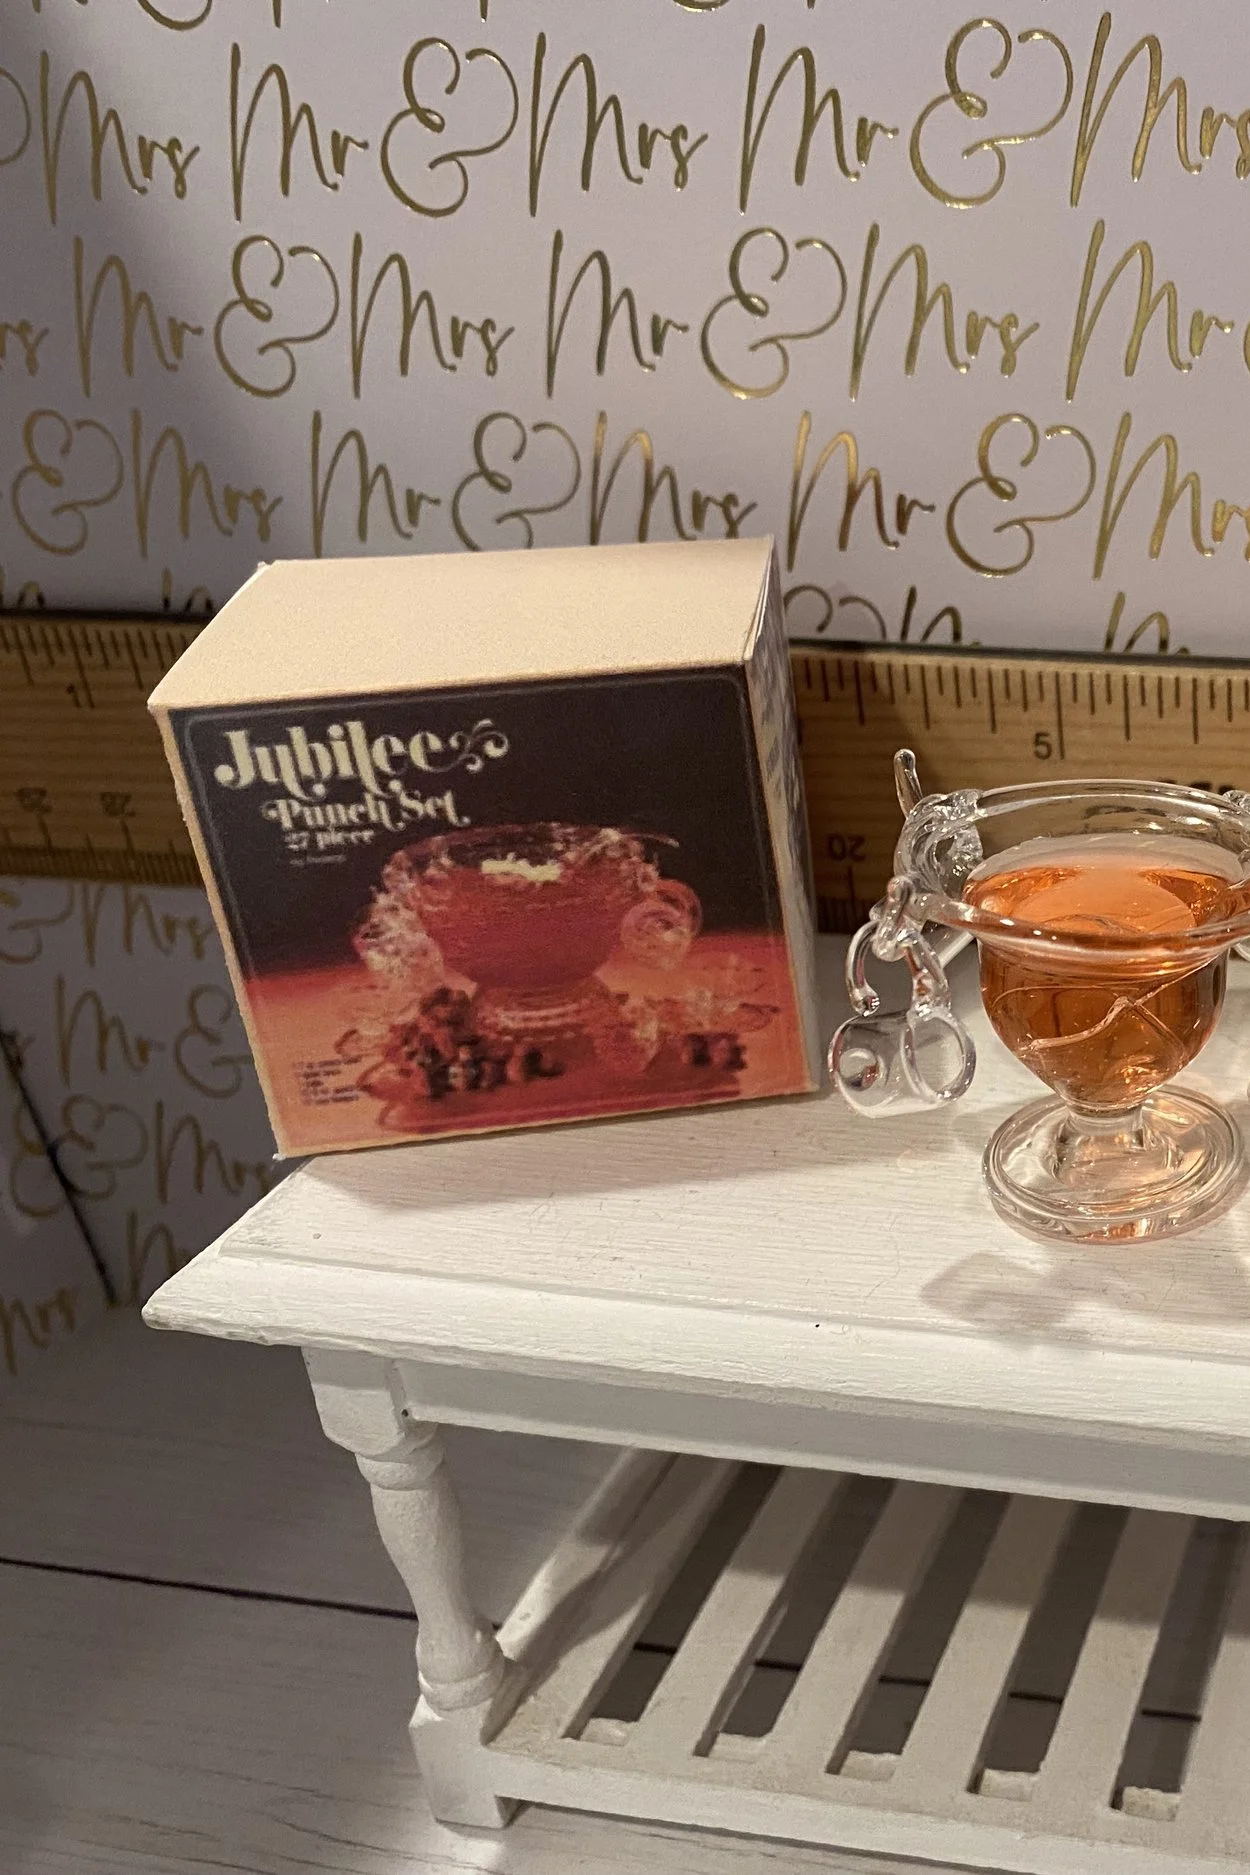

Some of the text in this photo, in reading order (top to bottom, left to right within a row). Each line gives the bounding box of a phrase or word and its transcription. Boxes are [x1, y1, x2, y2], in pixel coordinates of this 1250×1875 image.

[41, 51, 199, 225] Mrs
[231, 43, 367, 222] Mr
[381, 37, 519, 218] &
[530, 32, 708, 217] Mrs
[740, 24, 898, 214] Mr
[910, 17, 1073, 209] &
[73, 233, 514, 398] Mr & Mrs
[547, 223, 1039, 401] Mr & Mrs
[1067, 219, 1233, 402] Mr
[12, 409, 283, 558] & Mrs
[312, 411, 757, 557] Mr & Mrs
[788, 412, 935, 571] Mr
[946, 413, 1096, 578] &
[214, 719, 509, 801] Jubilee
[261, 789, 471, 832] Punch Set
[1034, 732, 1053, 760] 5
